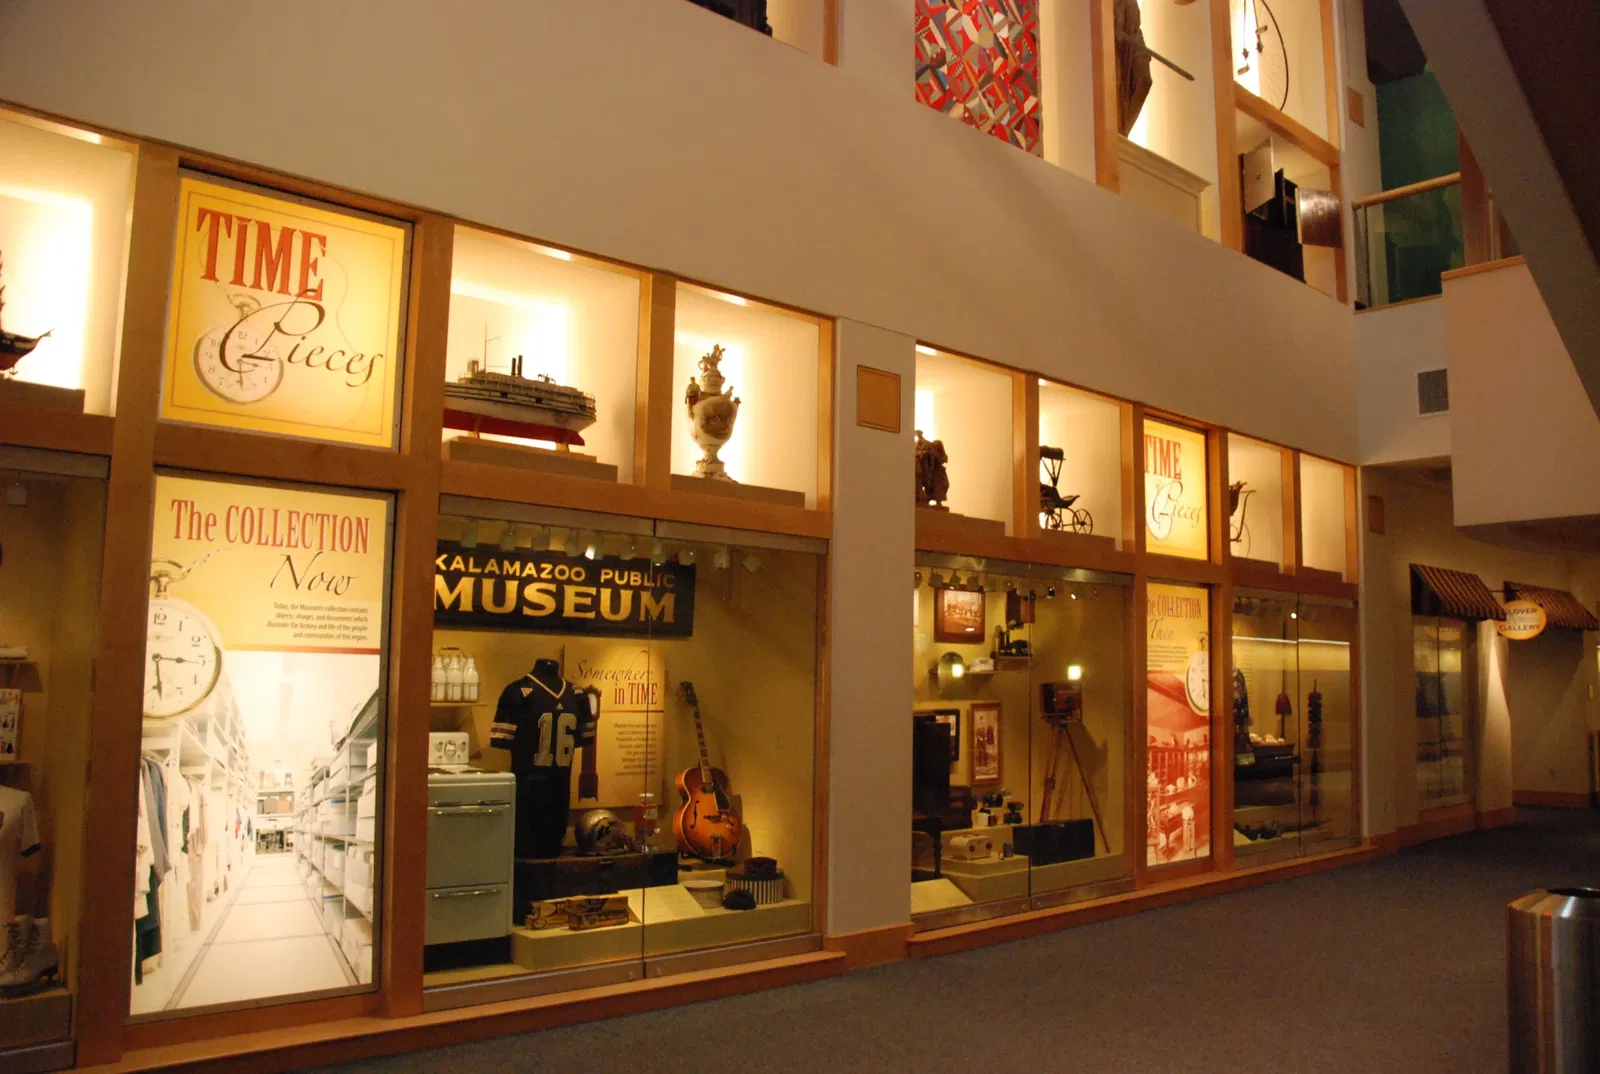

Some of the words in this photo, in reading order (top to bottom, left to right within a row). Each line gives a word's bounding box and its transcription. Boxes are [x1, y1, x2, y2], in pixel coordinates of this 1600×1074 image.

[196, 207, 327, 302] TIME
[219, 288, 384, 388] Pieces
[1144, 434, 1182, 481] TIME
[171, 499, 218, 542] The
[225, 504, 370, 554] COLLECTION
[1152, 480, 1203, 528] Pieces
[269, 551, 360, 596] Now
[435, 553, 586, 582] KALAMAZOO
[600, 568, 676, 588] PUBLIC
[434, 574, 676, 624] MUSEUM
[1157, 595, 1202, 619] COLLECTION
[1507, 607, 1537, 615] LOVER
[1499, 623, 1540, 631] GALLERY
[572, 651, 654, 682] Somewhere
[614, 683, 625, 705] in
[628, 683, 658, 705] TIME
[533, 712, 577, 767] 16
